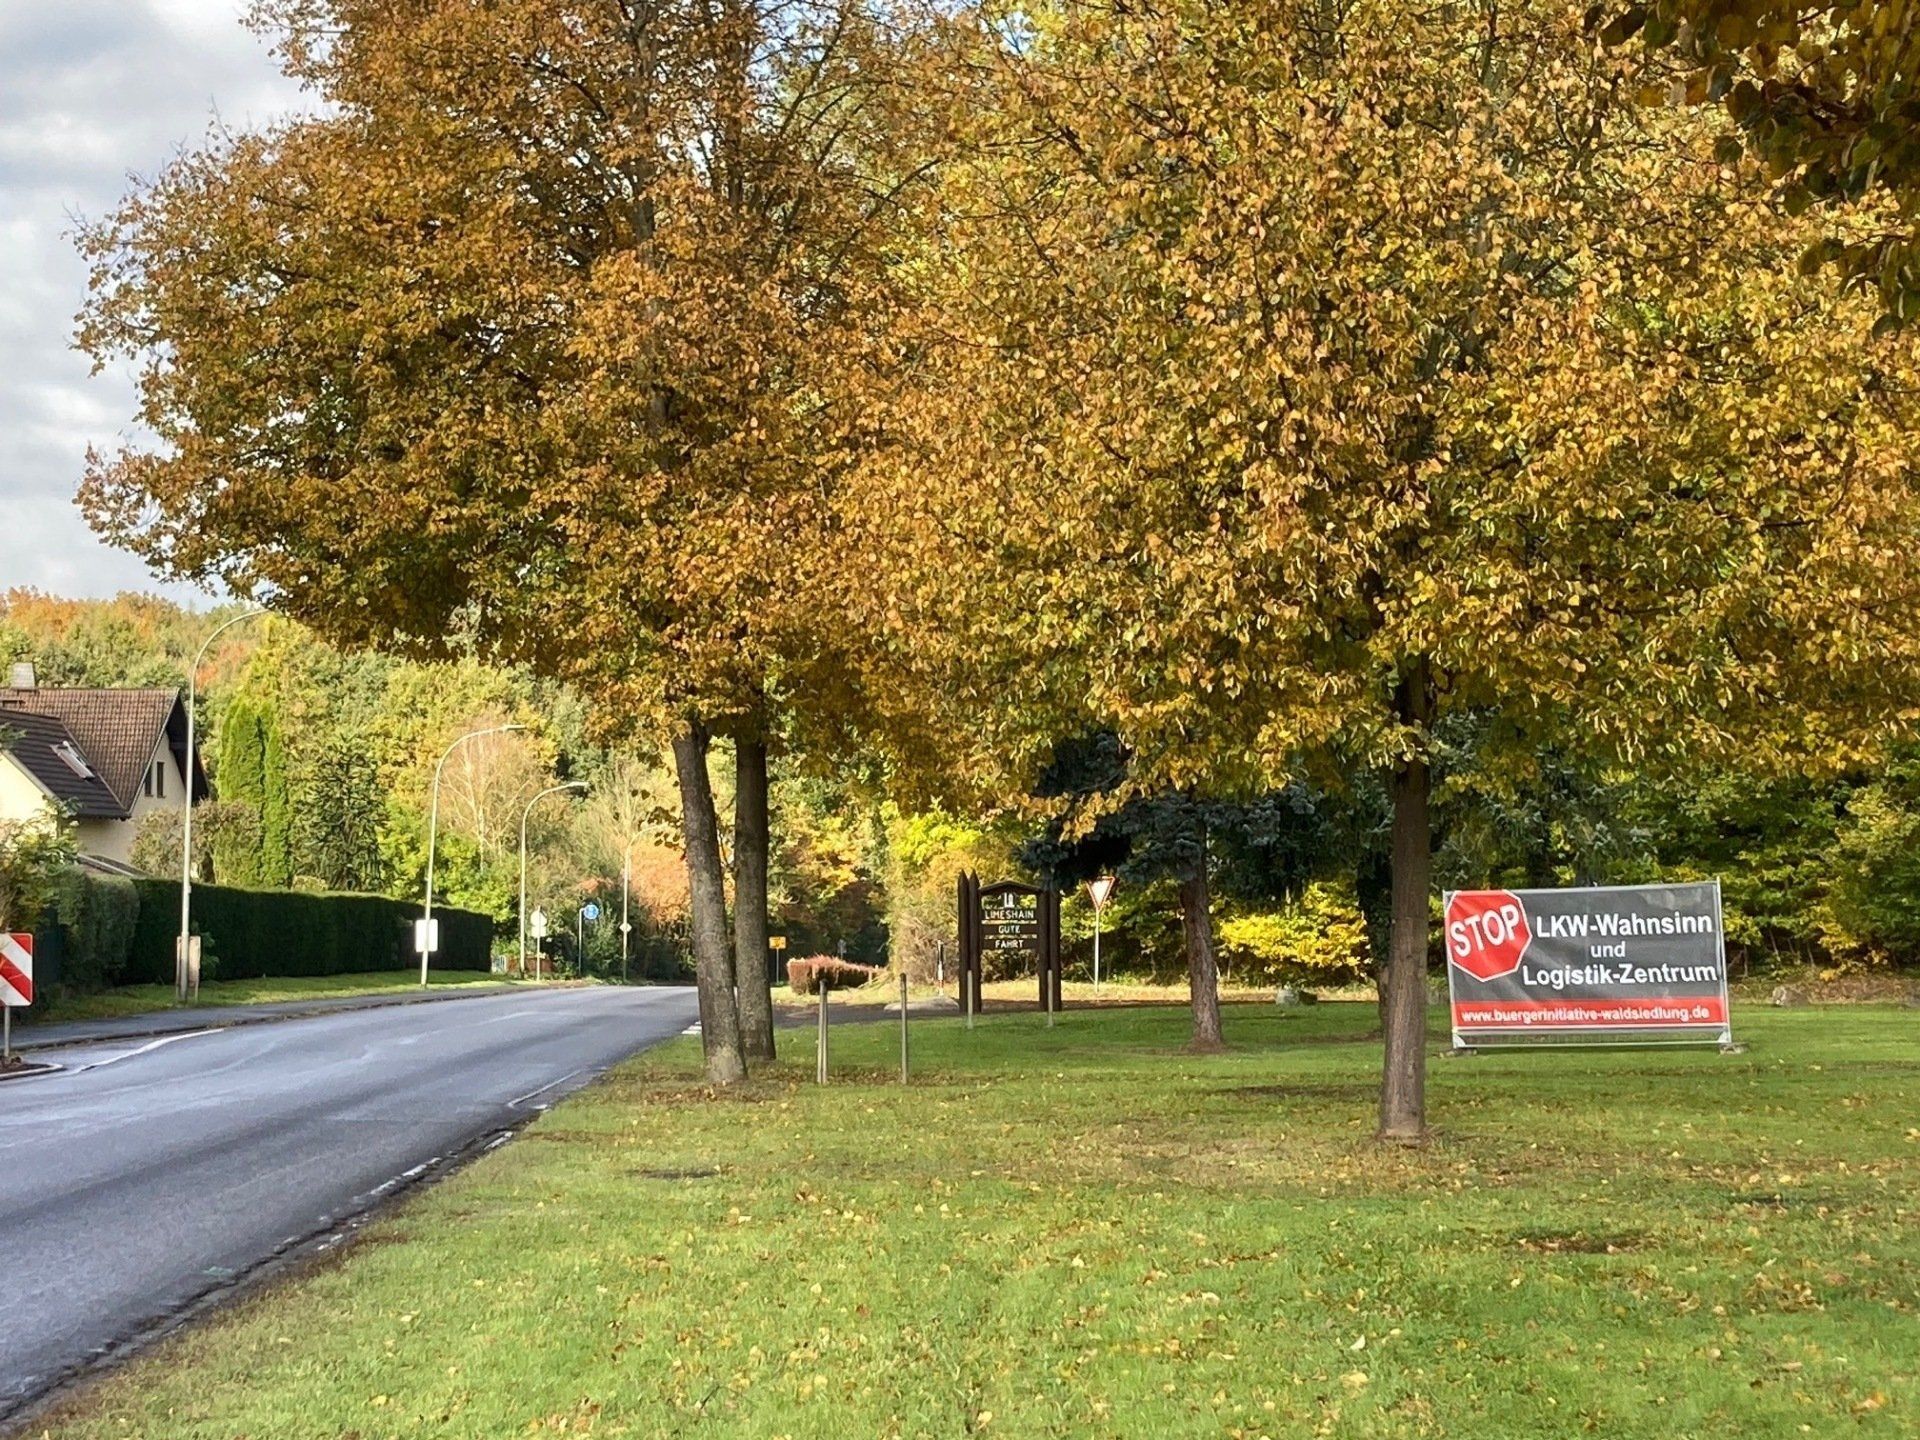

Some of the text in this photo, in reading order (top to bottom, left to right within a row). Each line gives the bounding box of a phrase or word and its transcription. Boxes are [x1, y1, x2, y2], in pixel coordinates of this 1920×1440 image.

[985, 910, 1034, 919] LIMESHAIN
[998, 925, 1020, 933] GUTE
[1450, 903, 1520, 957] STOP
[1536, 911, 1713, 938] LKW-Wahnsinn
[995, 940, 1024, 948] FAHRT
[1590, 940, 1626, 958] und
[1522, 963, 1717, 989] Logistik-Zentrum
[1461, 1005, 1710, 1024] www.buergerinitiative-waldsiedlung.de
